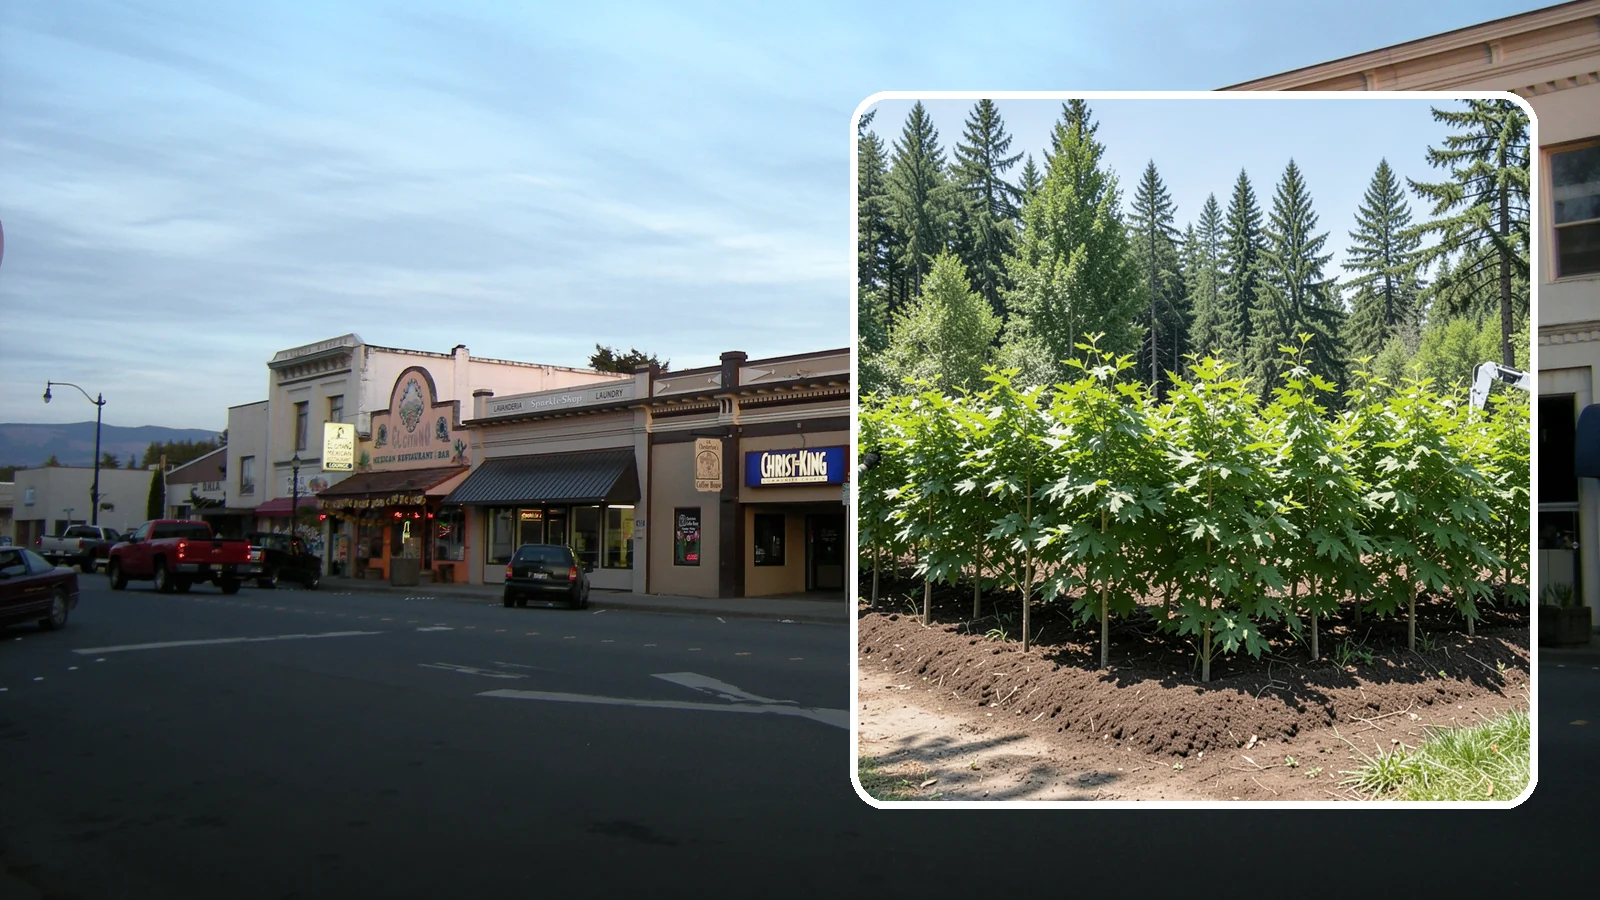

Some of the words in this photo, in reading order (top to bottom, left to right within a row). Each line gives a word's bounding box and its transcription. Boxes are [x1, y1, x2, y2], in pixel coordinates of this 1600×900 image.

[595, 389, 623, 399] LAUNDRY
[493, 402, 522, 412] LAVANDERIA
[530, 397, 561, 409] Sparkle
[562, 394, 582, 404] Shop
[373, 454, 396, 464] MEXICAN
[397, 452, 434, 462] RESTAURANT
[438, 450, 450, 459] BAR
[760, 452, 797, 478] CHRIST
[798, 450, 827, 476] KING
